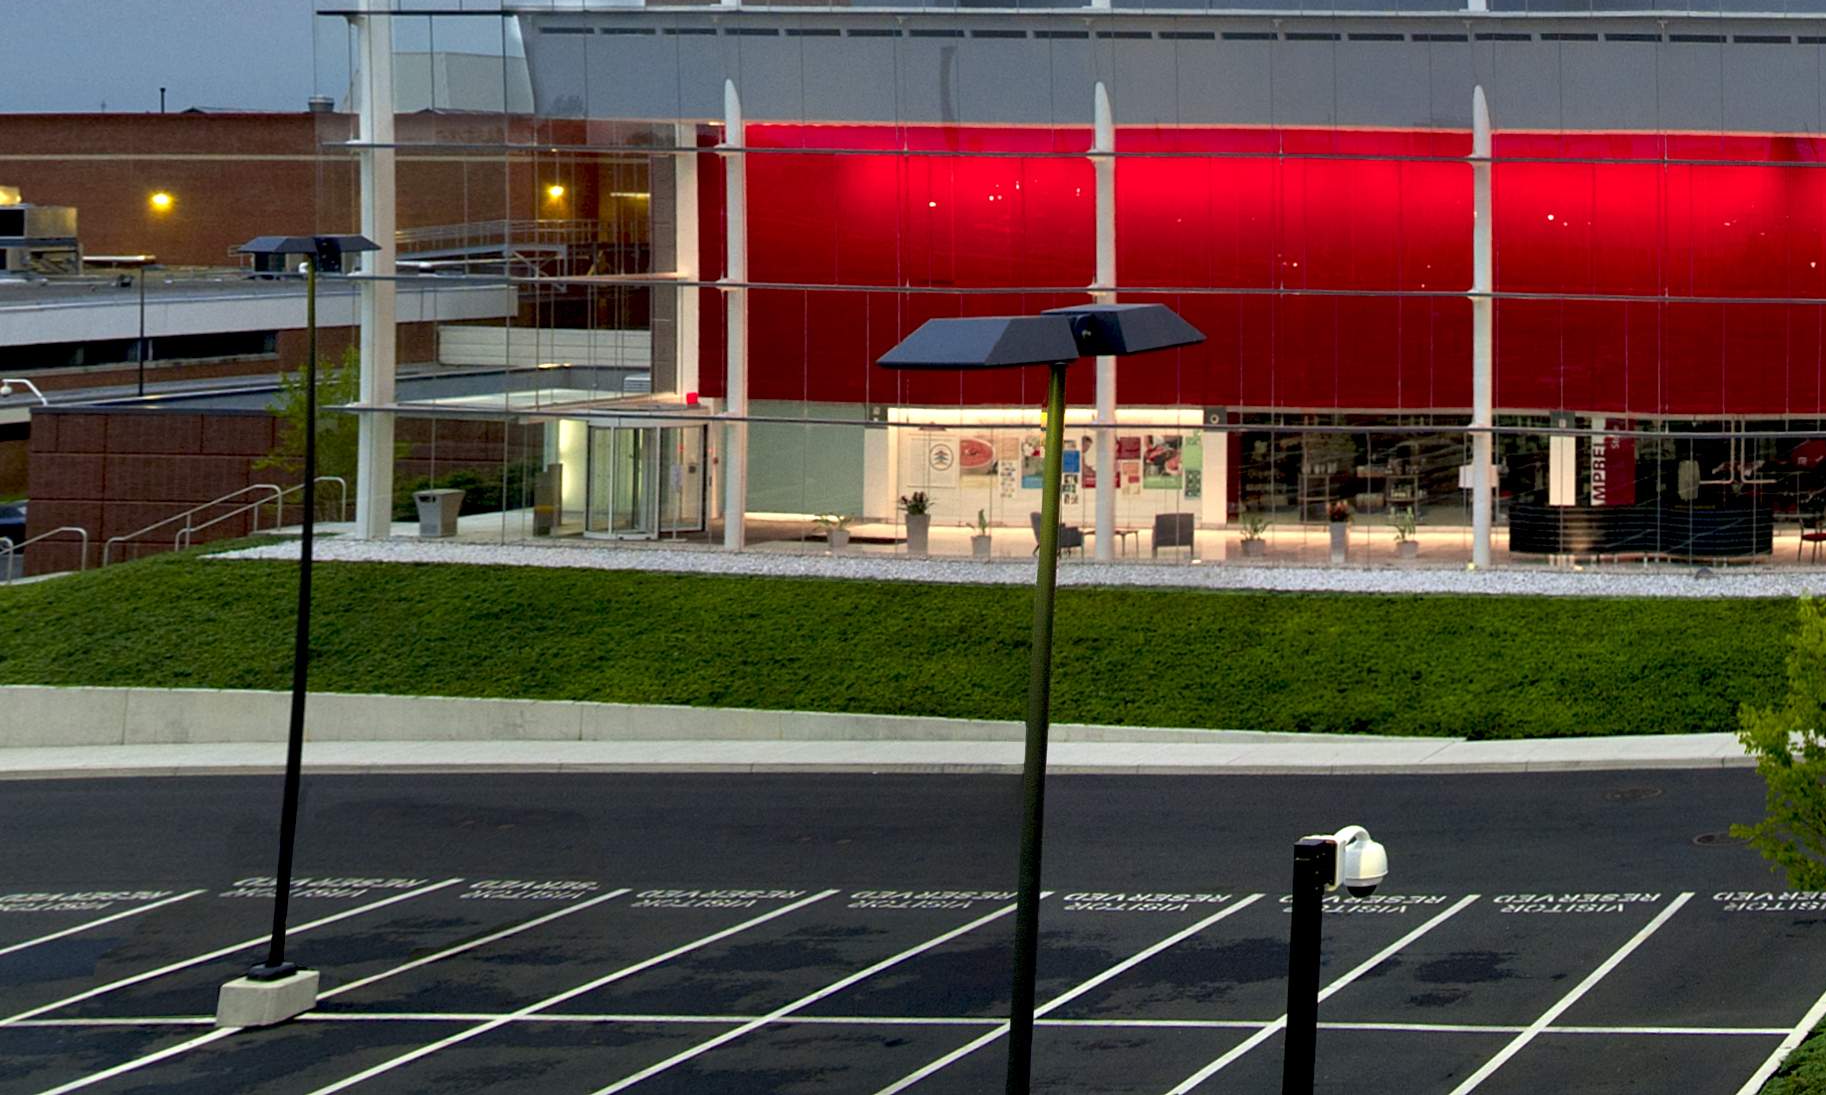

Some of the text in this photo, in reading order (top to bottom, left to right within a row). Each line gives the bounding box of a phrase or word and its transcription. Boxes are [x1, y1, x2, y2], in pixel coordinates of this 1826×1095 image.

[636, 890, 807, 899] RESERVED
[851, 891, 1018, 900] RESERVED
[1064, 892, 1232, 902] RESERVED
[1279, 894, 1447, 904] RESERVD
[1493, 893, 1662, 903] RESERVED
[631, 899, 757, 908] VISITOR
[848, 900, 974, 909] VISITOR
[1063, 902, 1190, 912] VISITOR
[1500, 903, 1624, 913] VISITOR
[1282, 904, 1407, 914] VISIT
